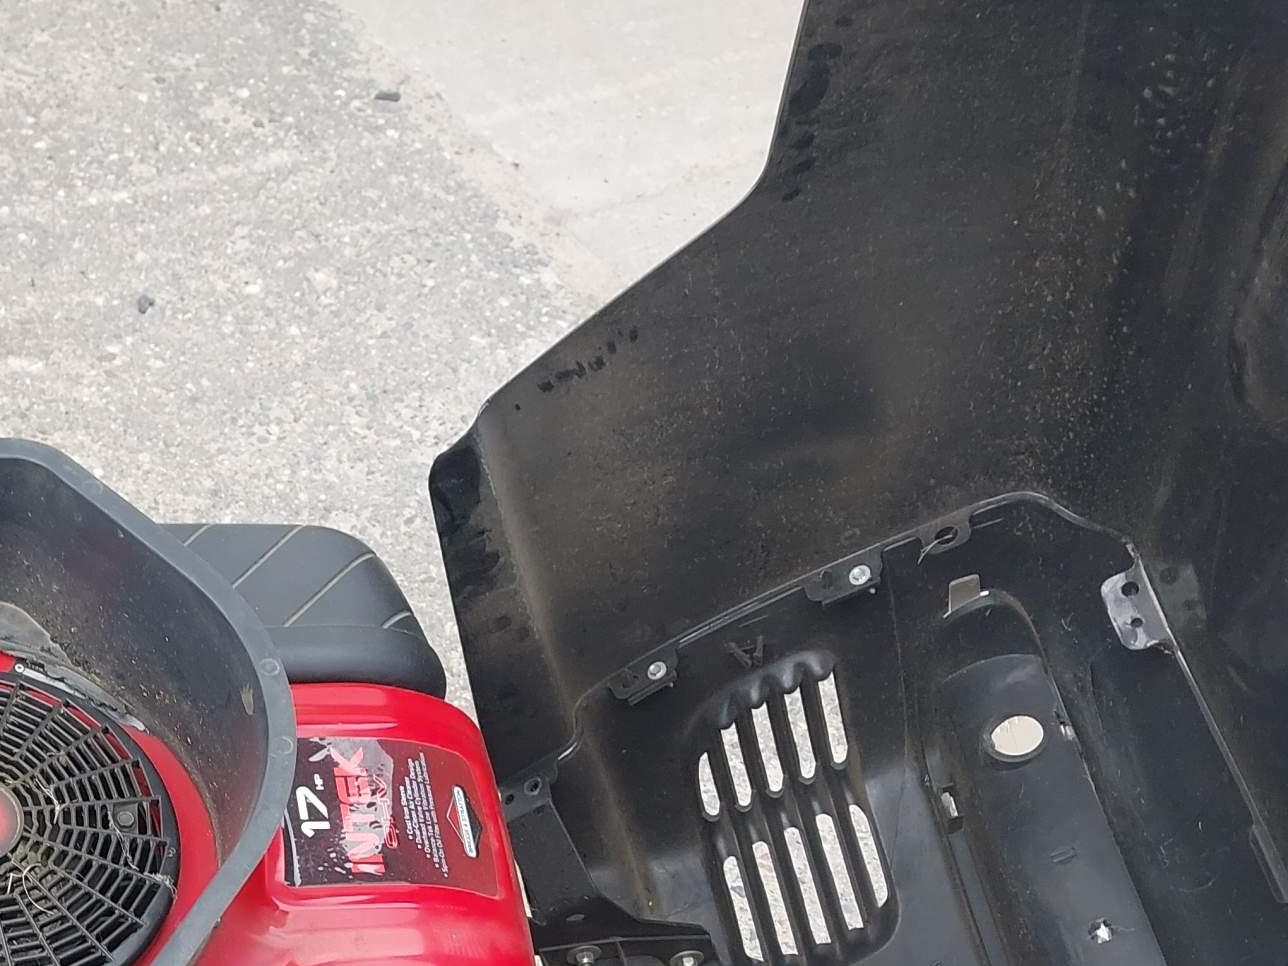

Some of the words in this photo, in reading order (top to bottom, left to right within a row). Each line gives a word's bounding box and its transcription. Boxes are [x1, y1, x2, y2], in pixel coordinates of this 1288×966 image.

[296, 786, 331, 838] 17
[314, 773, 326, 791] HP
[329, 747, 387, 876] INTEK
